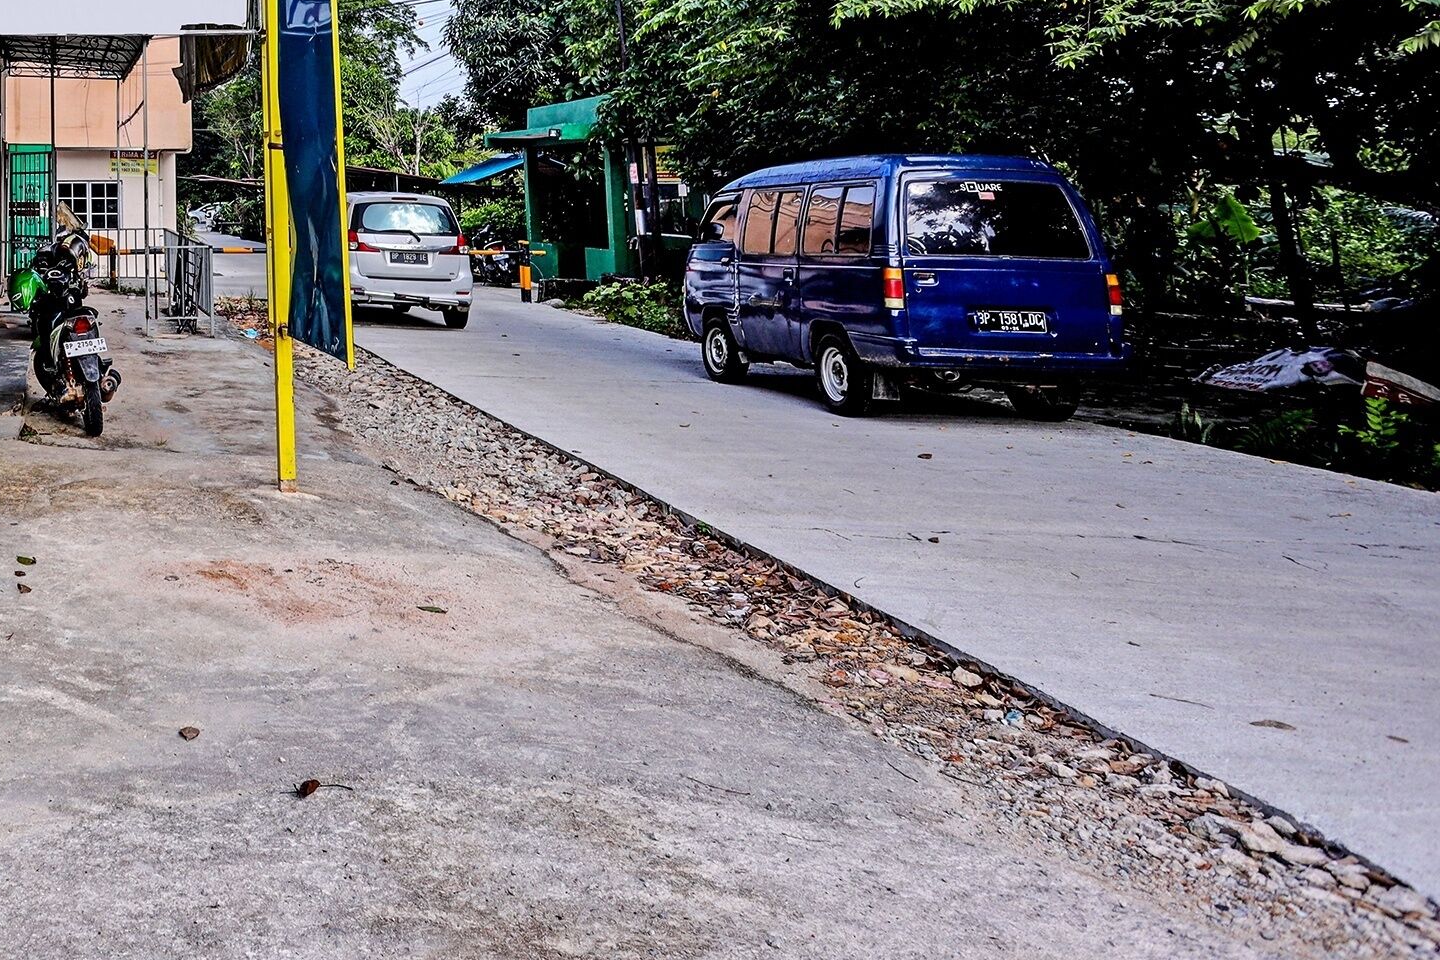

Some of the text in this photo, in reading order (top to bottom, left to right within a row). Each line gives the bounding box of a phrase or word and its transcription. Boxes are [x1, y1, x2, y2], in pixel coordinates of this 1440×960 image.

[960, 181, 1003, 193] SQUARE
[391, 252, 400, 260] BP
[999, 312, 1023, 325] 1581
[65, 342, 74, 350] BP
[77, 340, 93, 348] 2750
